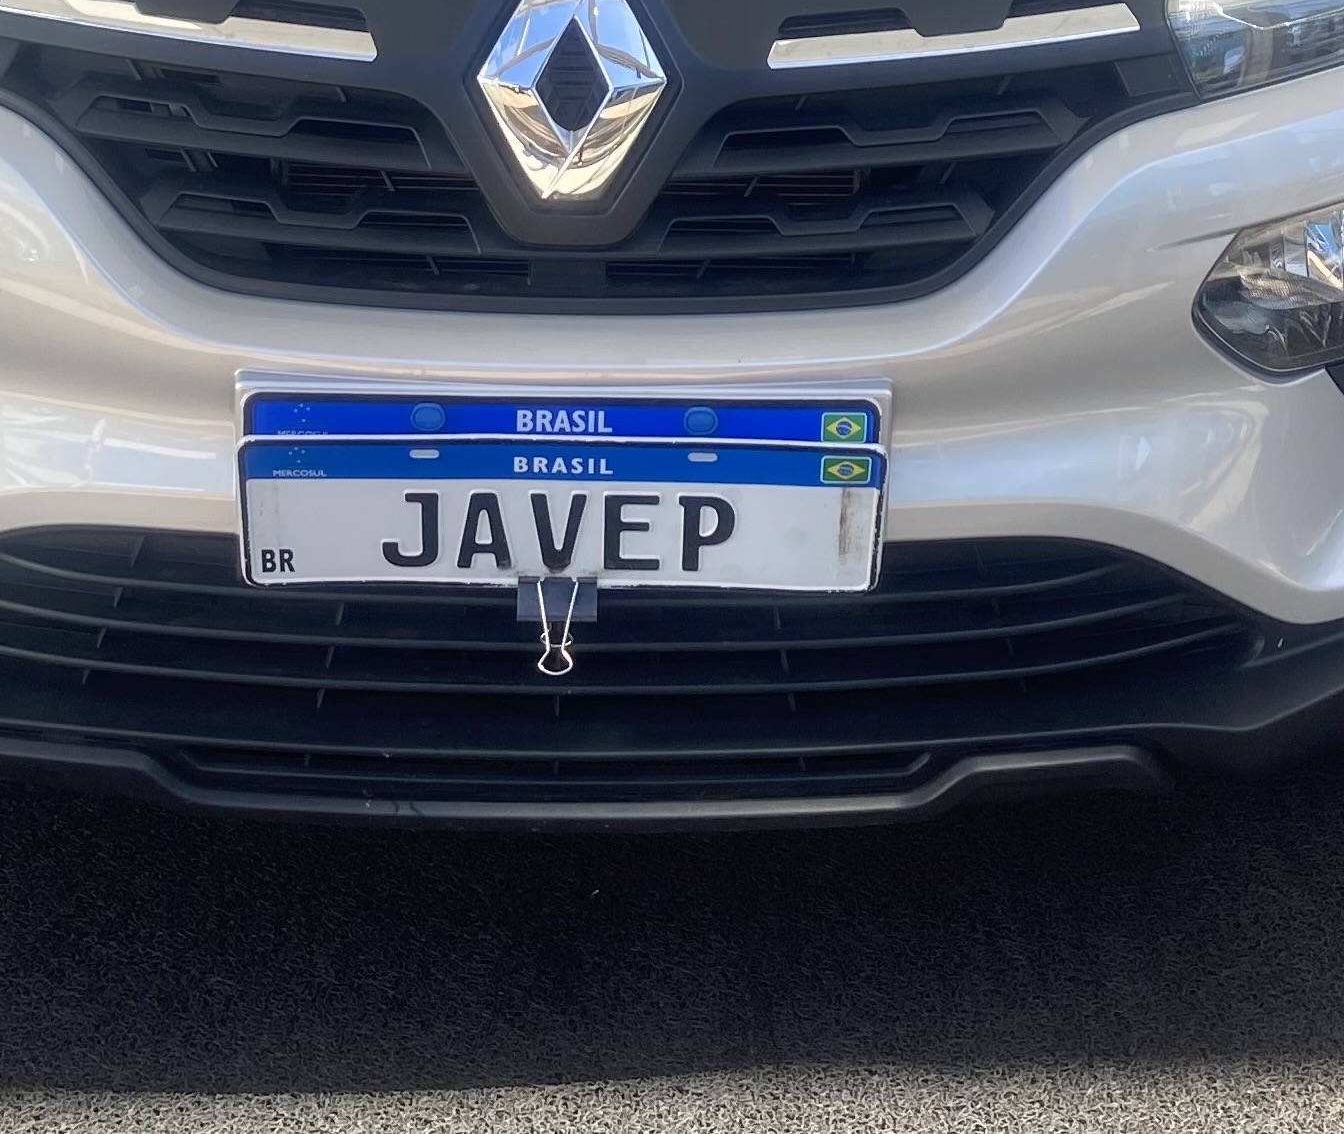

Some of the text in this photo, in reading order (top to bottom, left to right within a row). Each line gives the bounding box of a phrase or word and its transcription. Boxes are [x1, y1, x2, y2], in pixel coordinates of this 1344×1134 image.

[515, 408, 613, 434] BRASIL
[272, 469, 327, 477] MERCOSUL
[512, 455, 613, 475] BRASIL
[381, 491, 736, 574] JAVEP
[260, 549, 295, 573] BR
